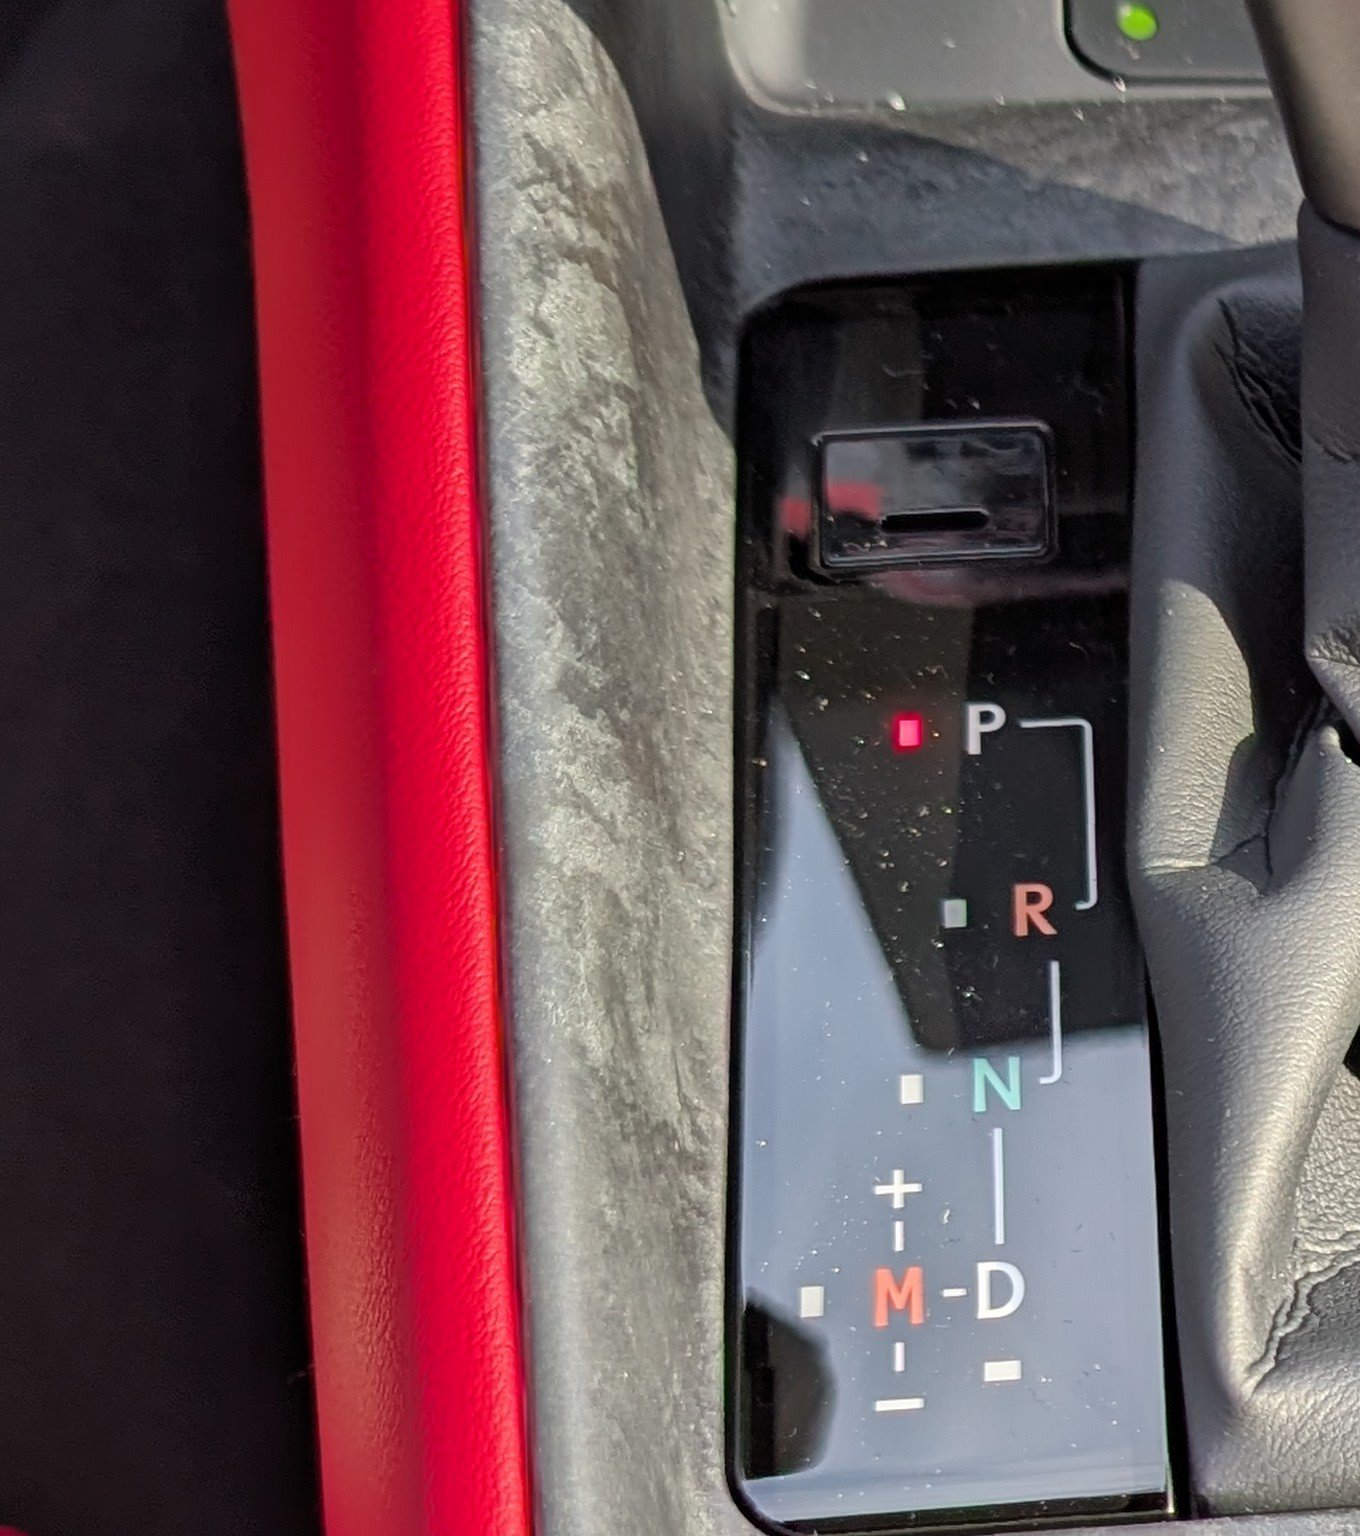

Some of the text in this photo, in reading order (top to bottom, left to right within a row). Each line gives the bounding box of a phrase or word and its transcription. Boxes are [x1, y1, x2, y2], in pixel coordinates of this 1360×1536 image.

[966, 703, 1006, 755] P
[1012, 882, 1057, 937] R
[972, 1055, 1022, 1115] N
